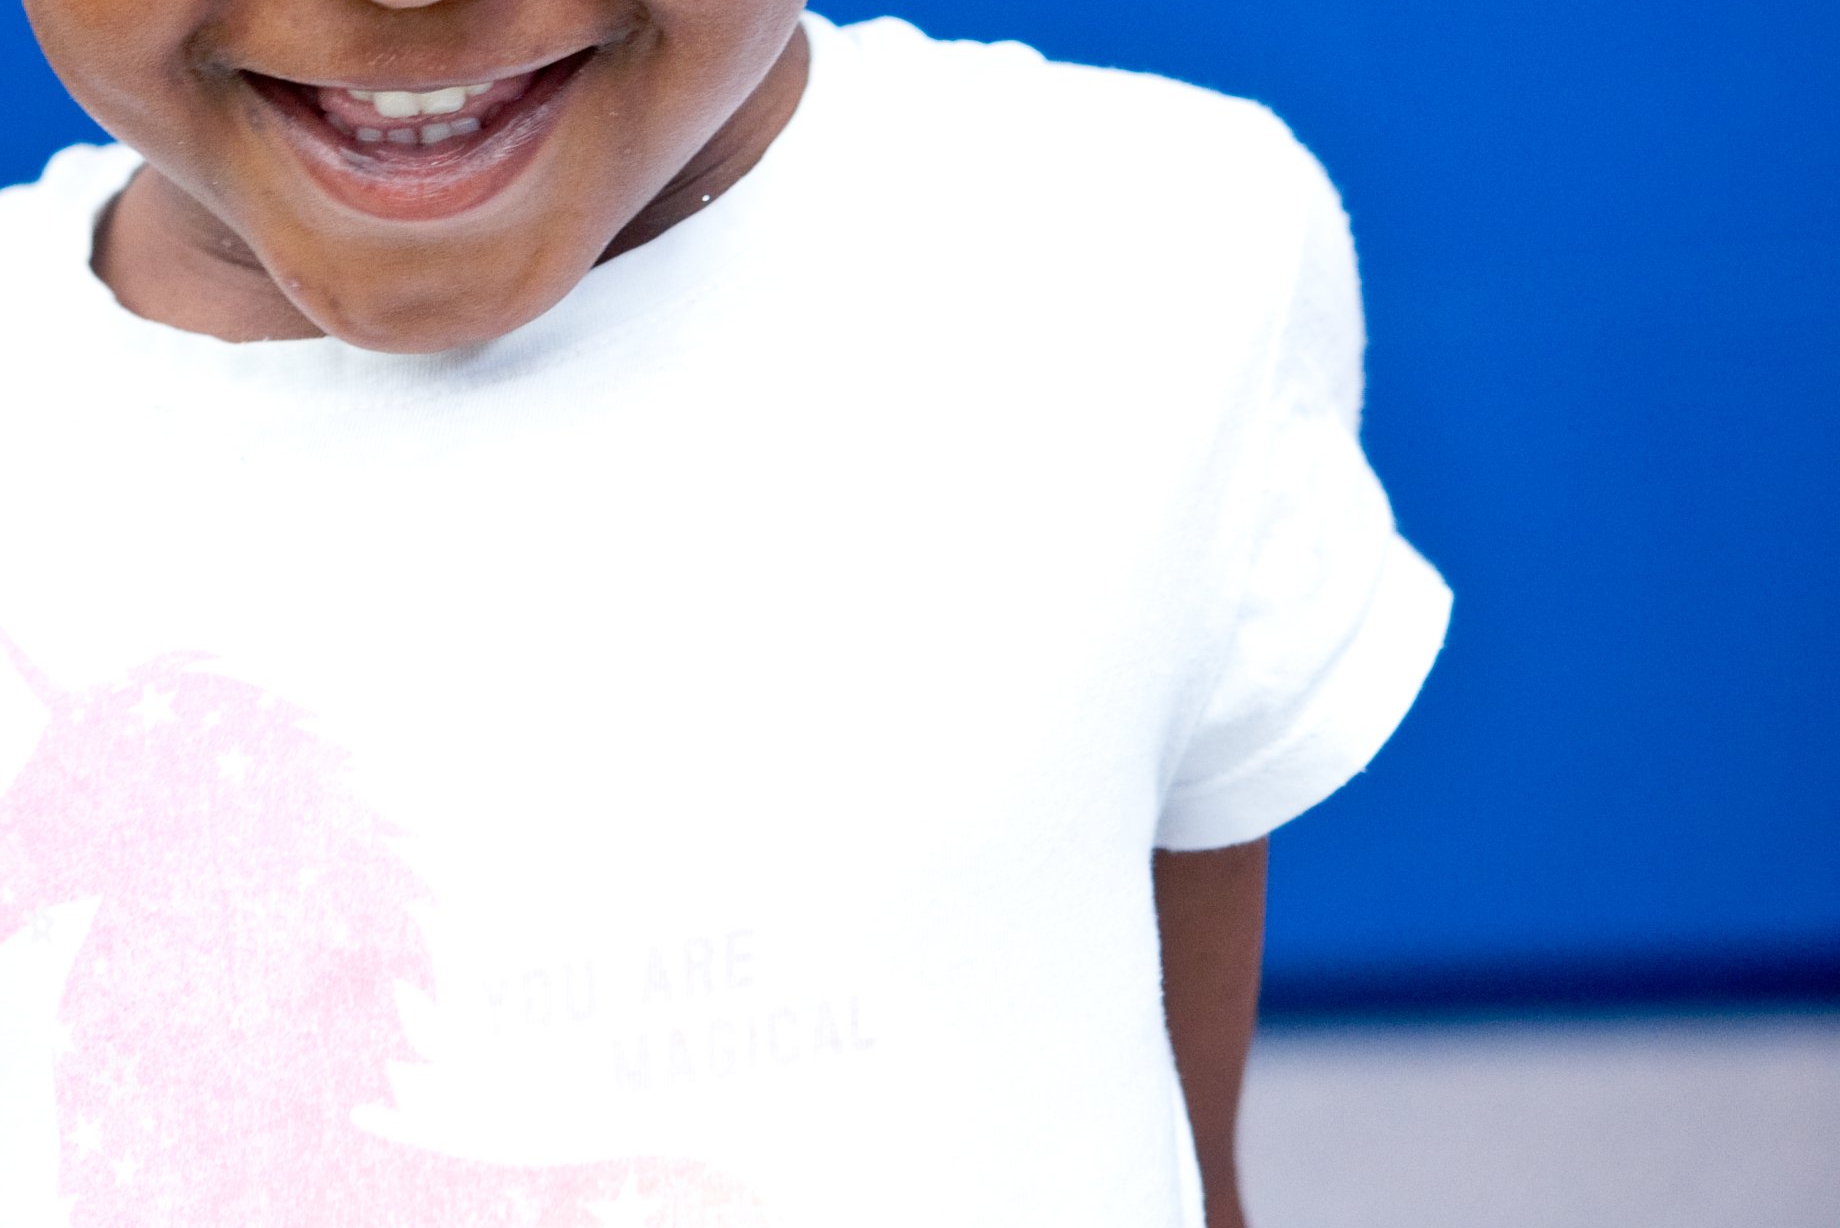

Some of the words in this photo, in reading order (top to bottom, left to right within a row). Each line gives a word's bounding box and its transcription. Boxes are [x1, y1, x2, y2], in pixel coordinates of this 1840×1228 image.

[484, 958, 596, 1035] YOU
[642, 927, 757, 1003] ARE
[612, 994, 878, 1090] MAGICAL
